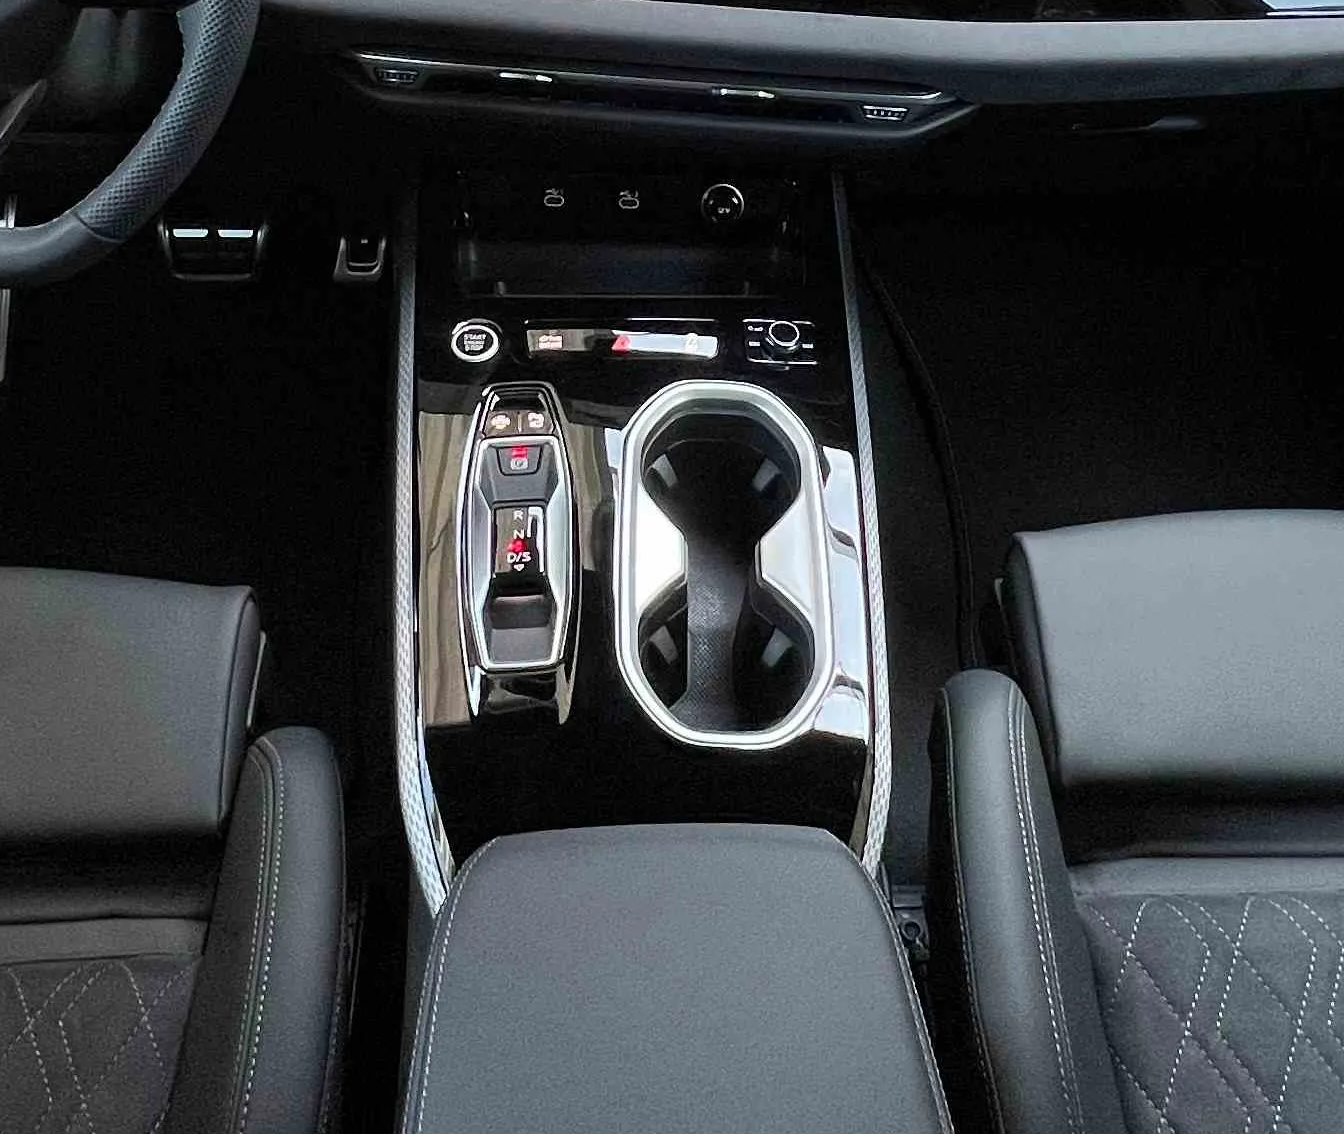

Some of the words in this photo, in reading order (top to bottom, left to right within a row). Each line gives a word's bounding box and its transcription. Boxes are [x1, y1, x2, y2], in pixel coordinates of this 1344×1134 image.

[512, 509, 524, 521] R
[512, 529, 525, 540] N
[506, 551, 532, 565] D/S
